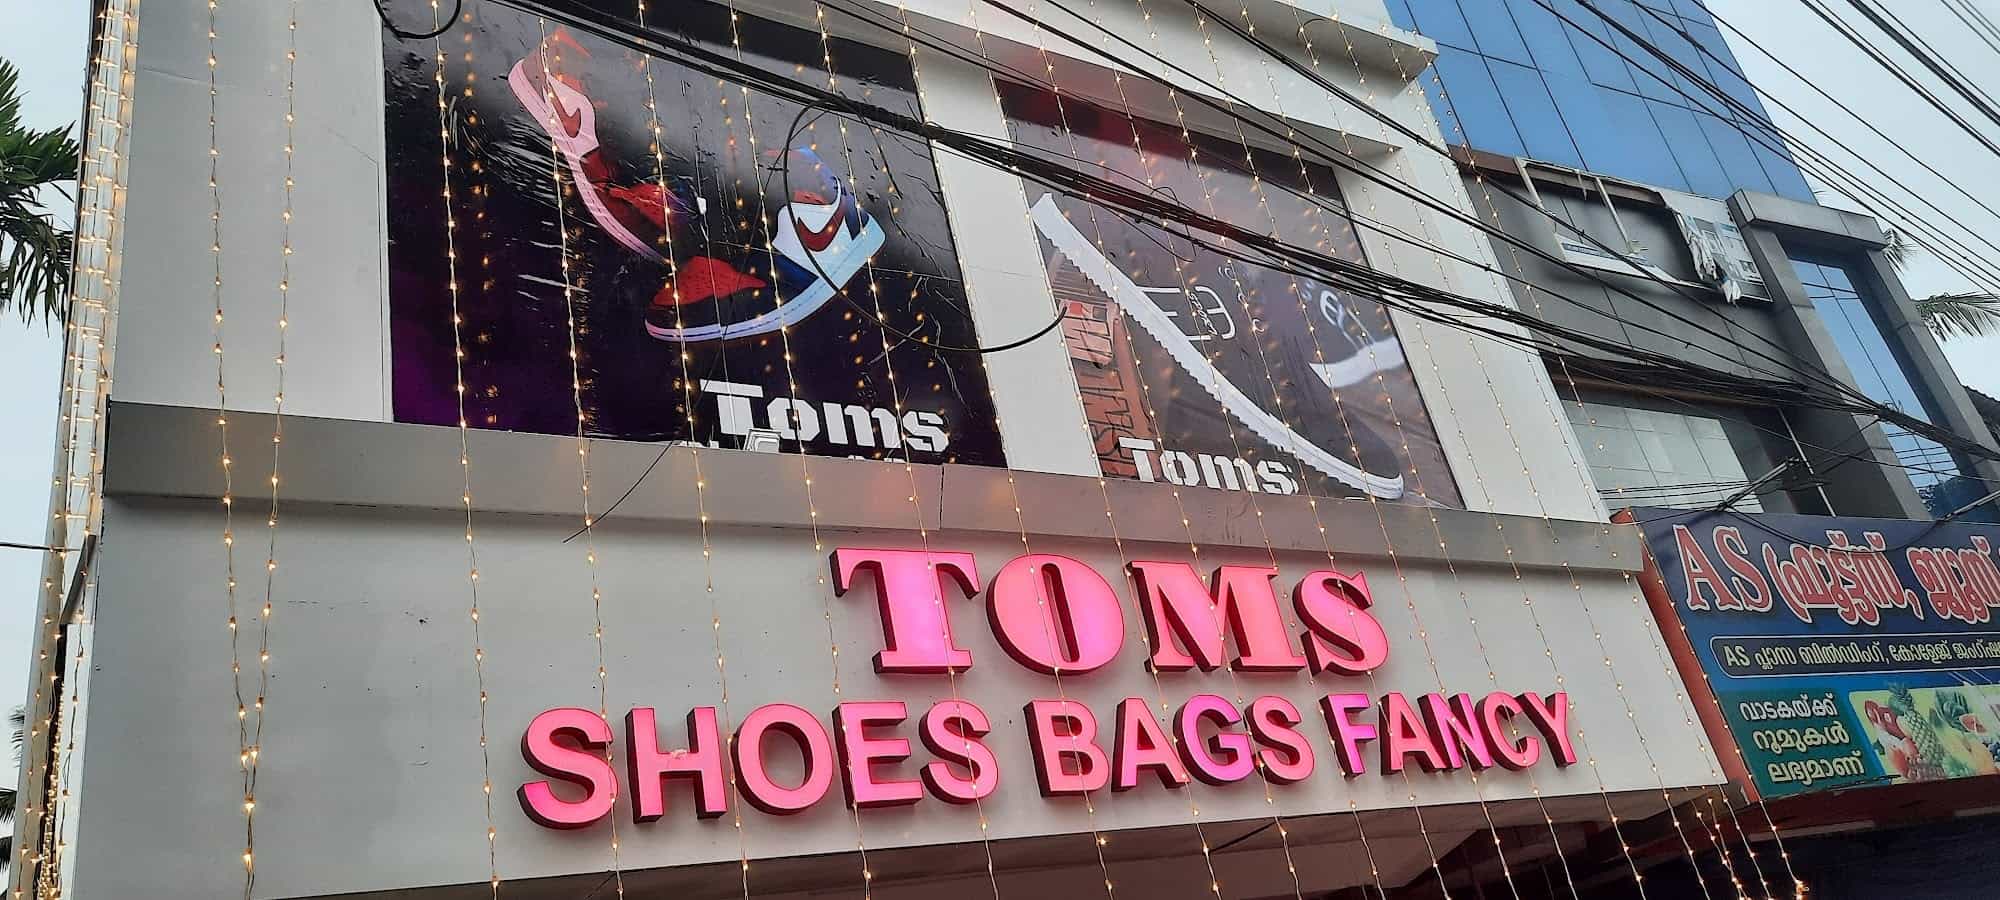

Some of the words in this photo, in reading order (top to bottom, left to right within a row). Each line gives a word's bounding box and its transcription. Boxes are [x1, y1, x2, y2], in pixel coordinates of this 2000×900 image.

[699, 378, 950, 453] Toms
[1117, 436, 1301, 496] Toms
[1672, 524, 1773, 612] AS
[831, 547, 1388, 676] TOMS
[1723, 645, 1750, 667] AS
[517, 699, 1000, 830] SHOES
[1022, 692, 1315, 798] BAGS
[1319, 690, 1578, 778] FANCY
[1752, 721, 1851, 754] റൂമുകൾ
[1766, 749, 1866, 786] ലഭ്യമാണ്
